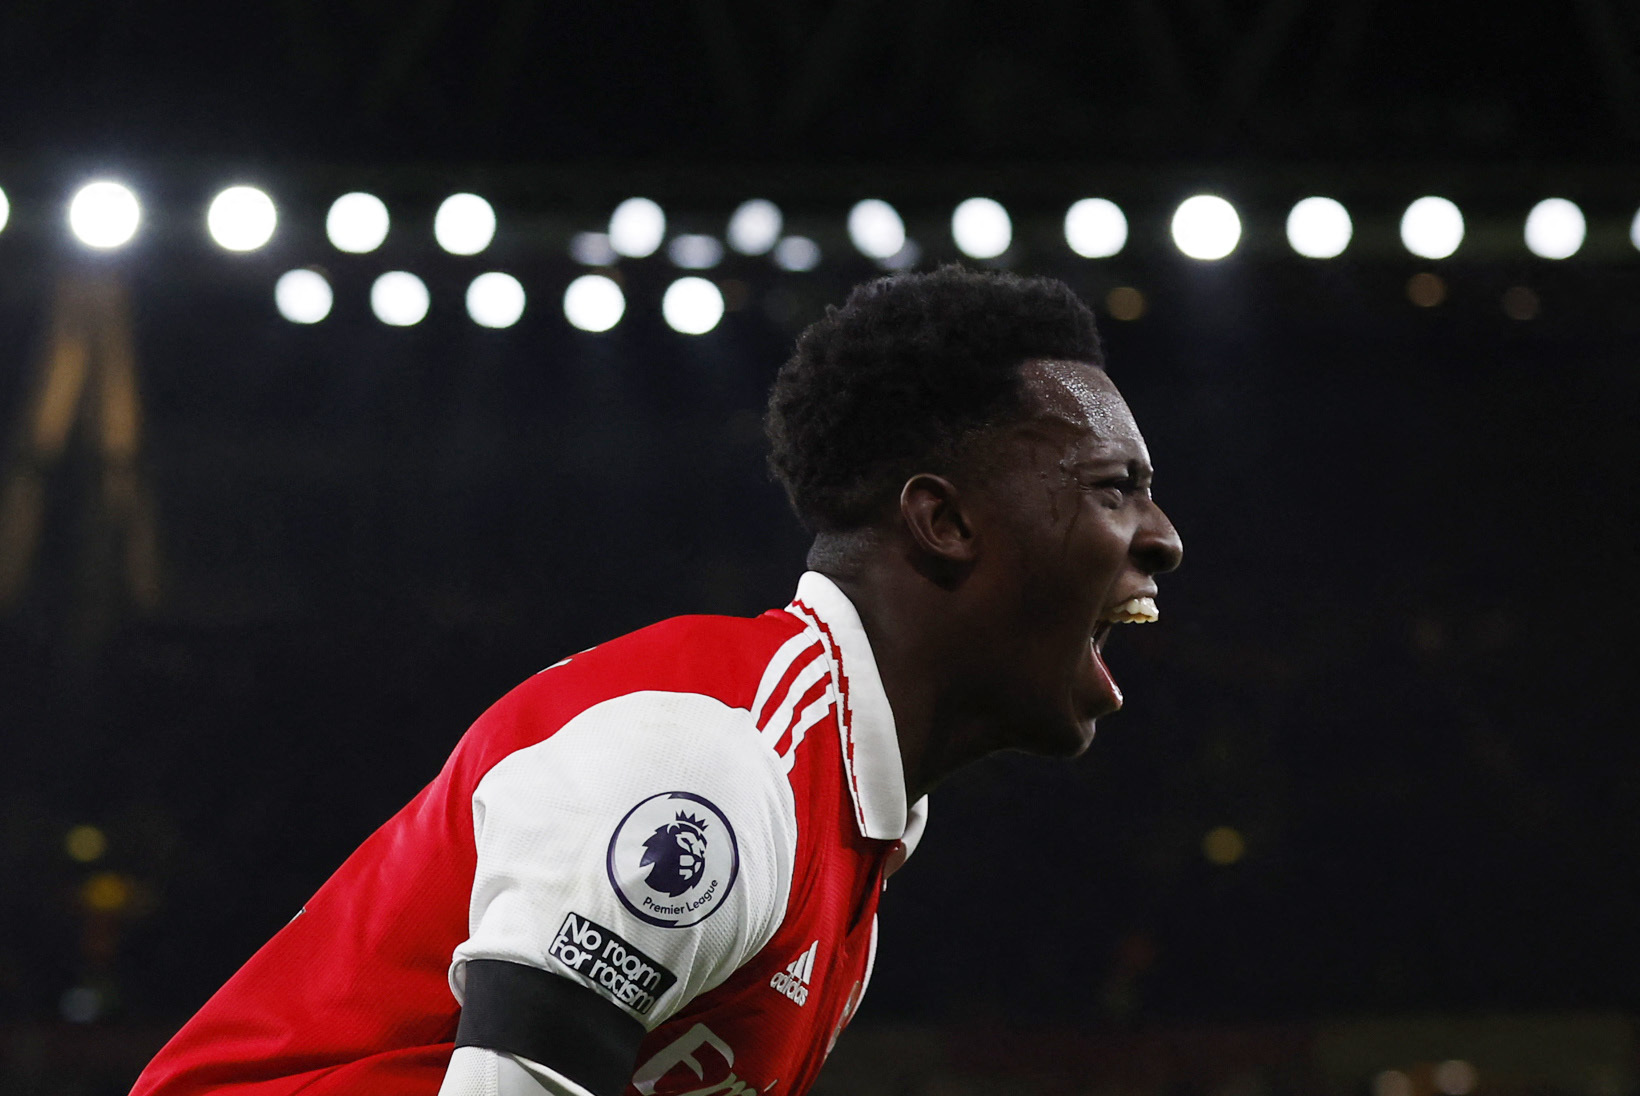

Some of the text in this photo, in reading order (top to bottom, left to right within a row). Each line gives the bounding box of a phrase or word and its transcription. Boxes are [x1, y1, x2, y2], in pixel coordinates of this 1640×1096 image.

[643, 879, 718, 915] Premier League
[550, 933, 655, 1013] for racism
[559, 914, 662, 991] No room
[770, 971, 809, 1007] adidas
